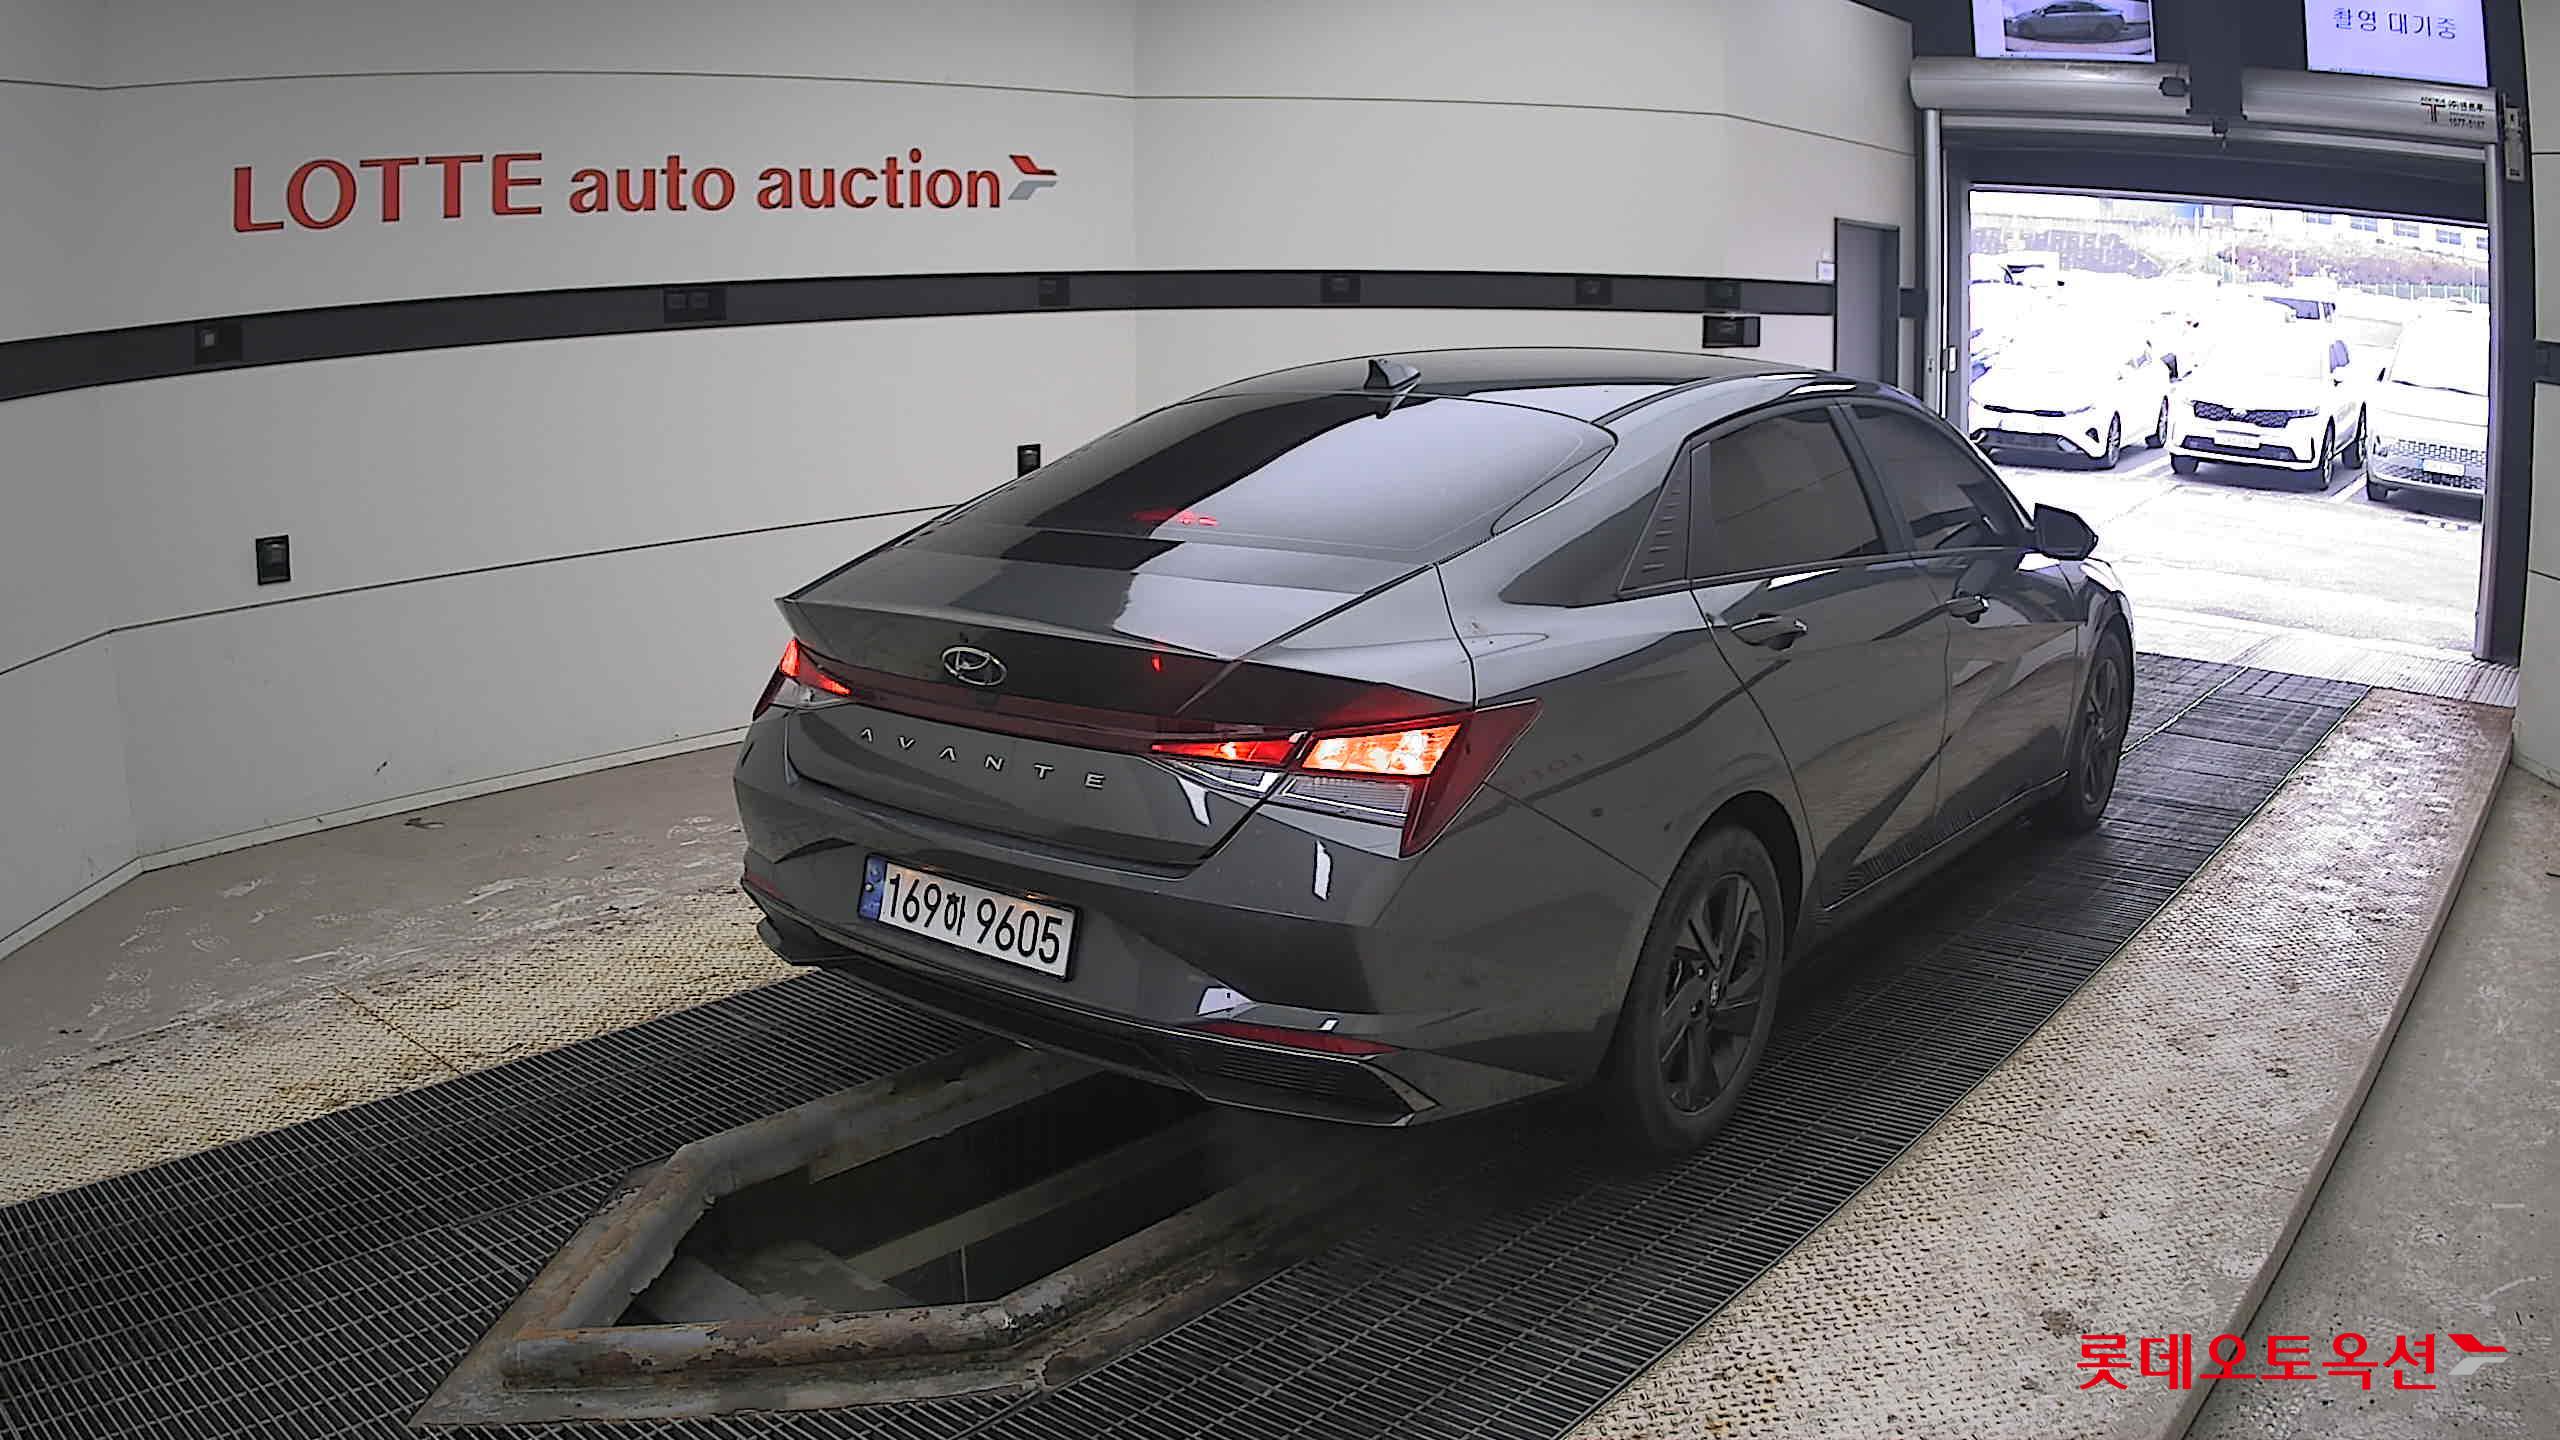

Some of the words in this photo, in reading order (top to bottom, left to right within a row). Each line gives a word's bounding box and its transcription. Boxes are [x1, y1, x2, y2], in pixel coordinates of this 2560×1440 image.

[2387, 11, 2457, 40] 대기중
[233, 152, 543, 233] LOTTE
[569, 154, 736, 213] auto
[757, 148, 1001, 209] auction
[860, 727, 1106, 789] AVANTE
[974, 897, 1064, 965] 9605
